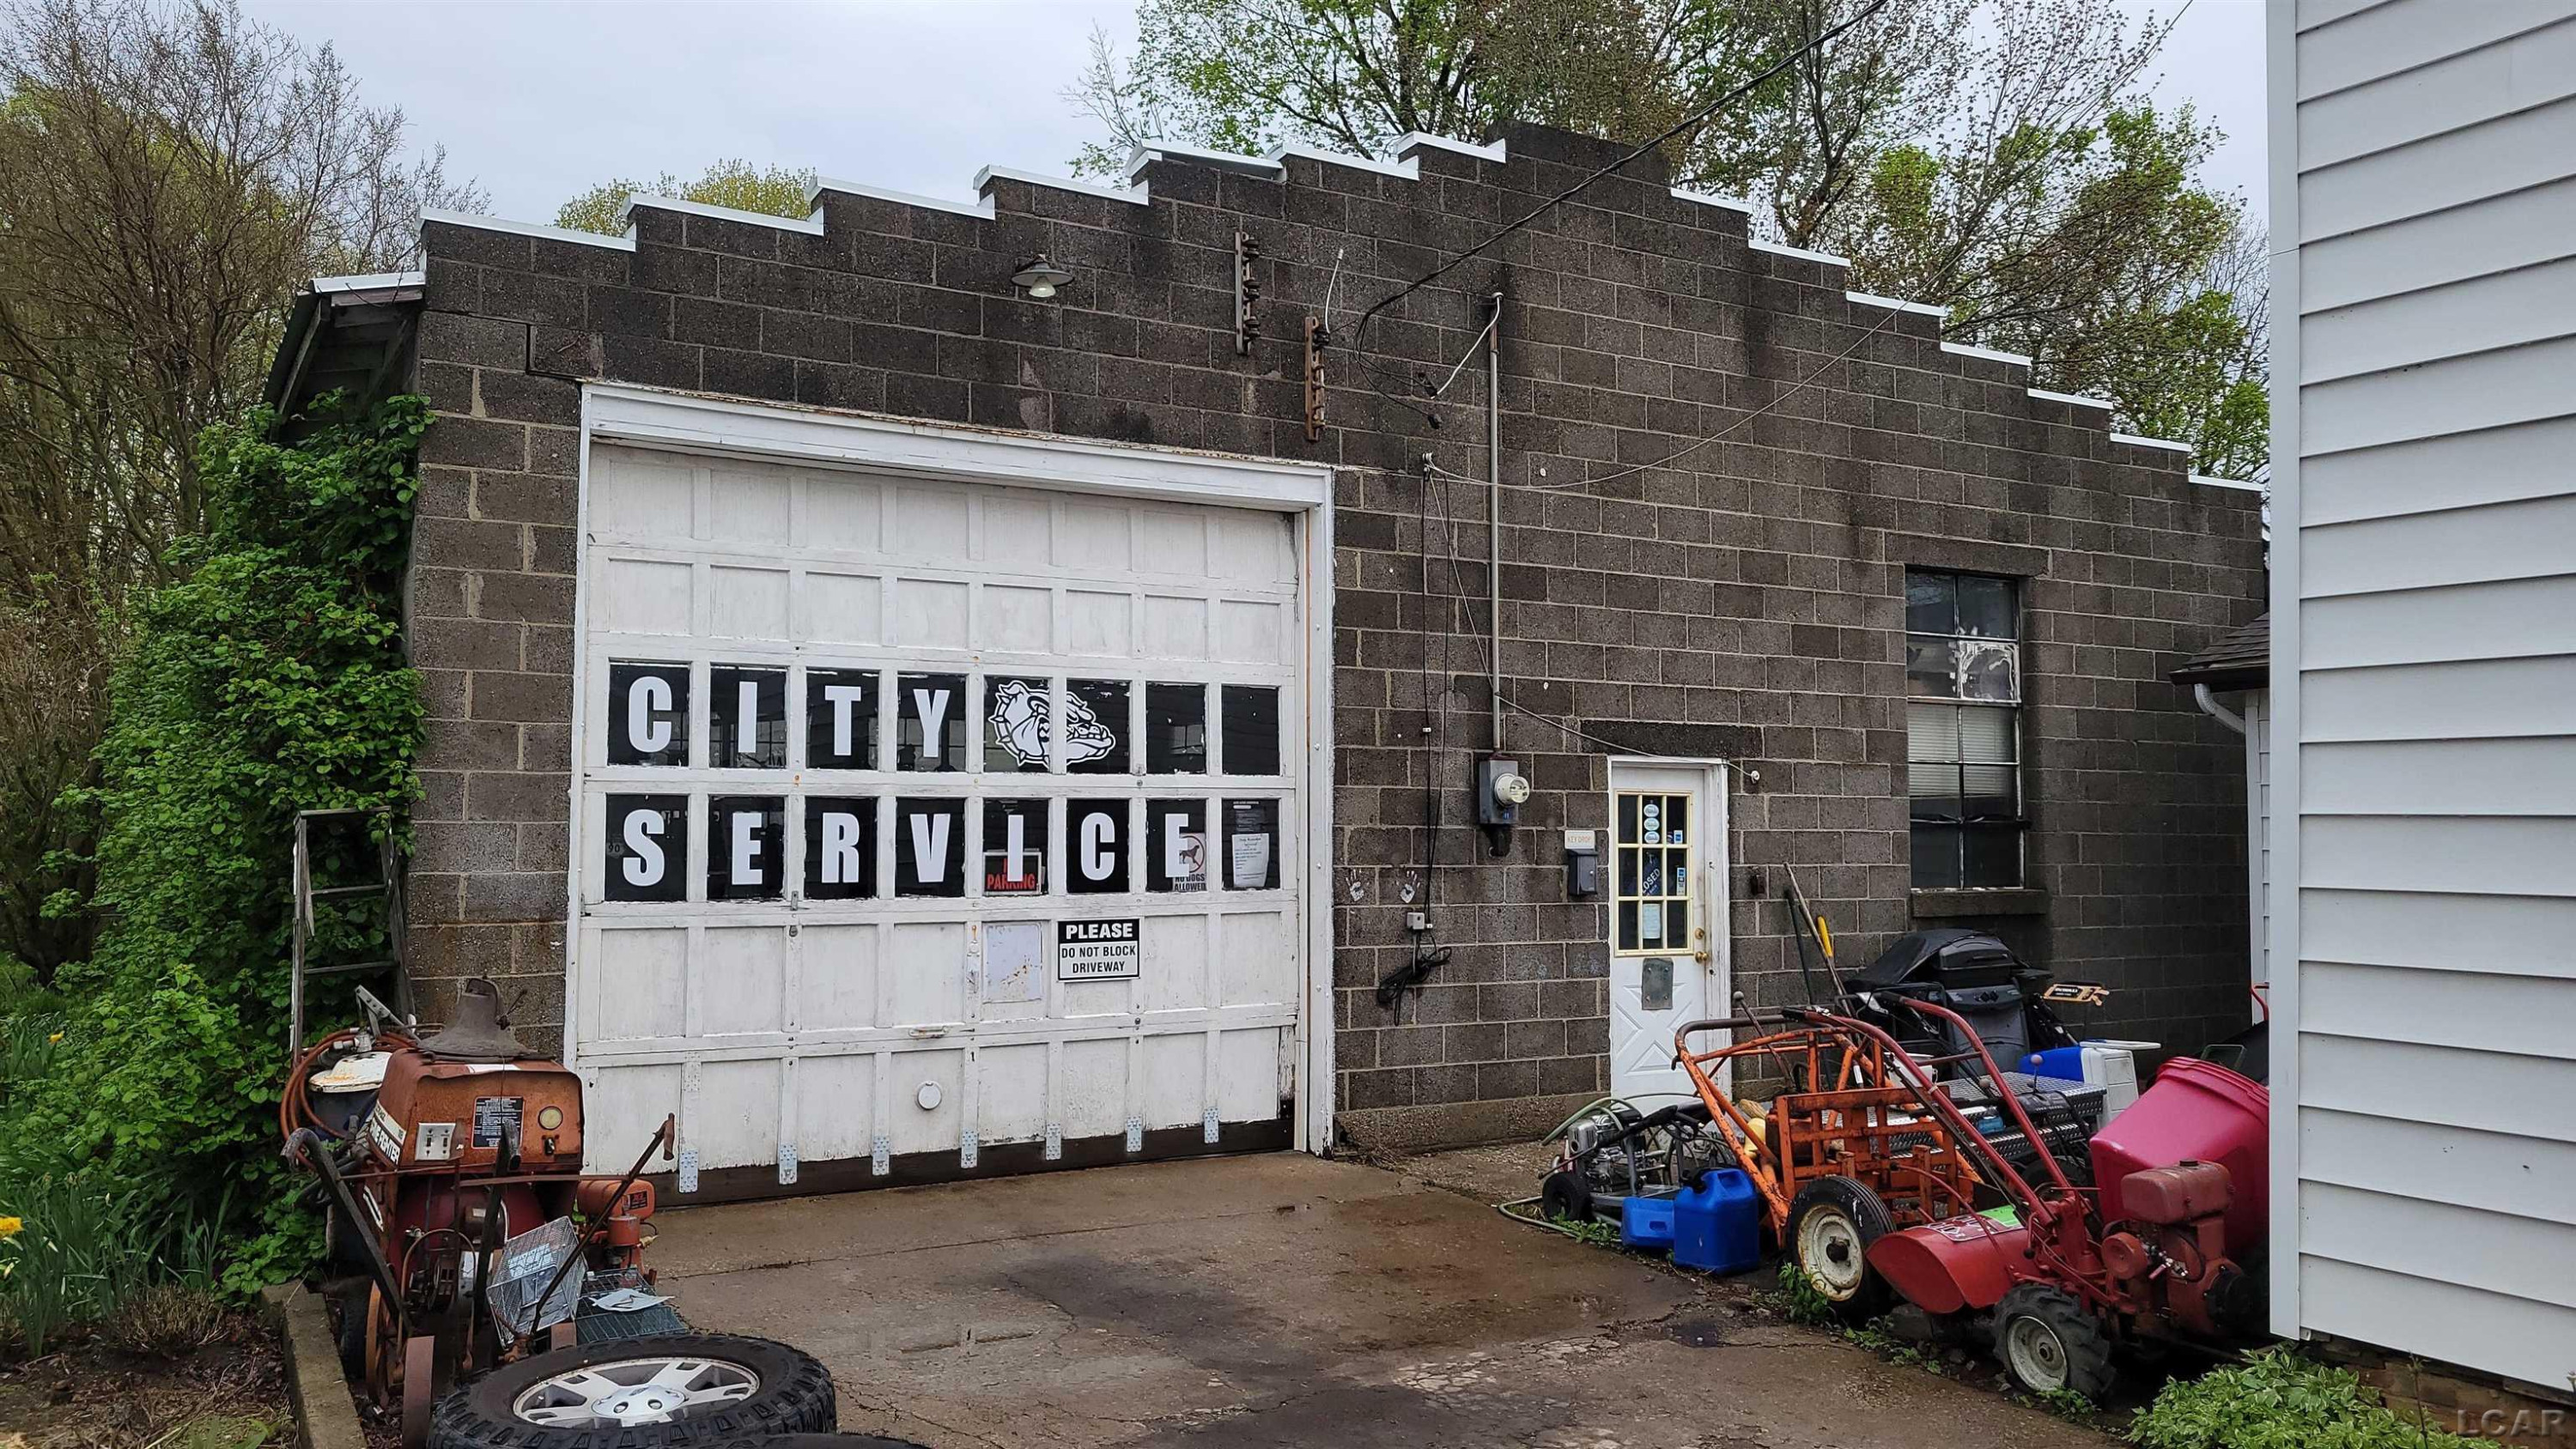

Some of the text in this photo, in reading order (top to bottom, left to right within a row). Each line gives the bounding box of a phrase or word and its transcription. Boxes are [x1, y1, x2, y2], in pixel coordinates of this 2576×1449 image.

[629, 676, 951, 758] CITY
[623, 809, 1190, 887] SERVICE
[1643, 869, 1661, 894] LOSED
[1066, 923, 1133, 940] PLEASE
[1061, 945, 1136, 958] DO NOT BLOCK
[1072, 961, 1126, 973] DRIVEWAY
